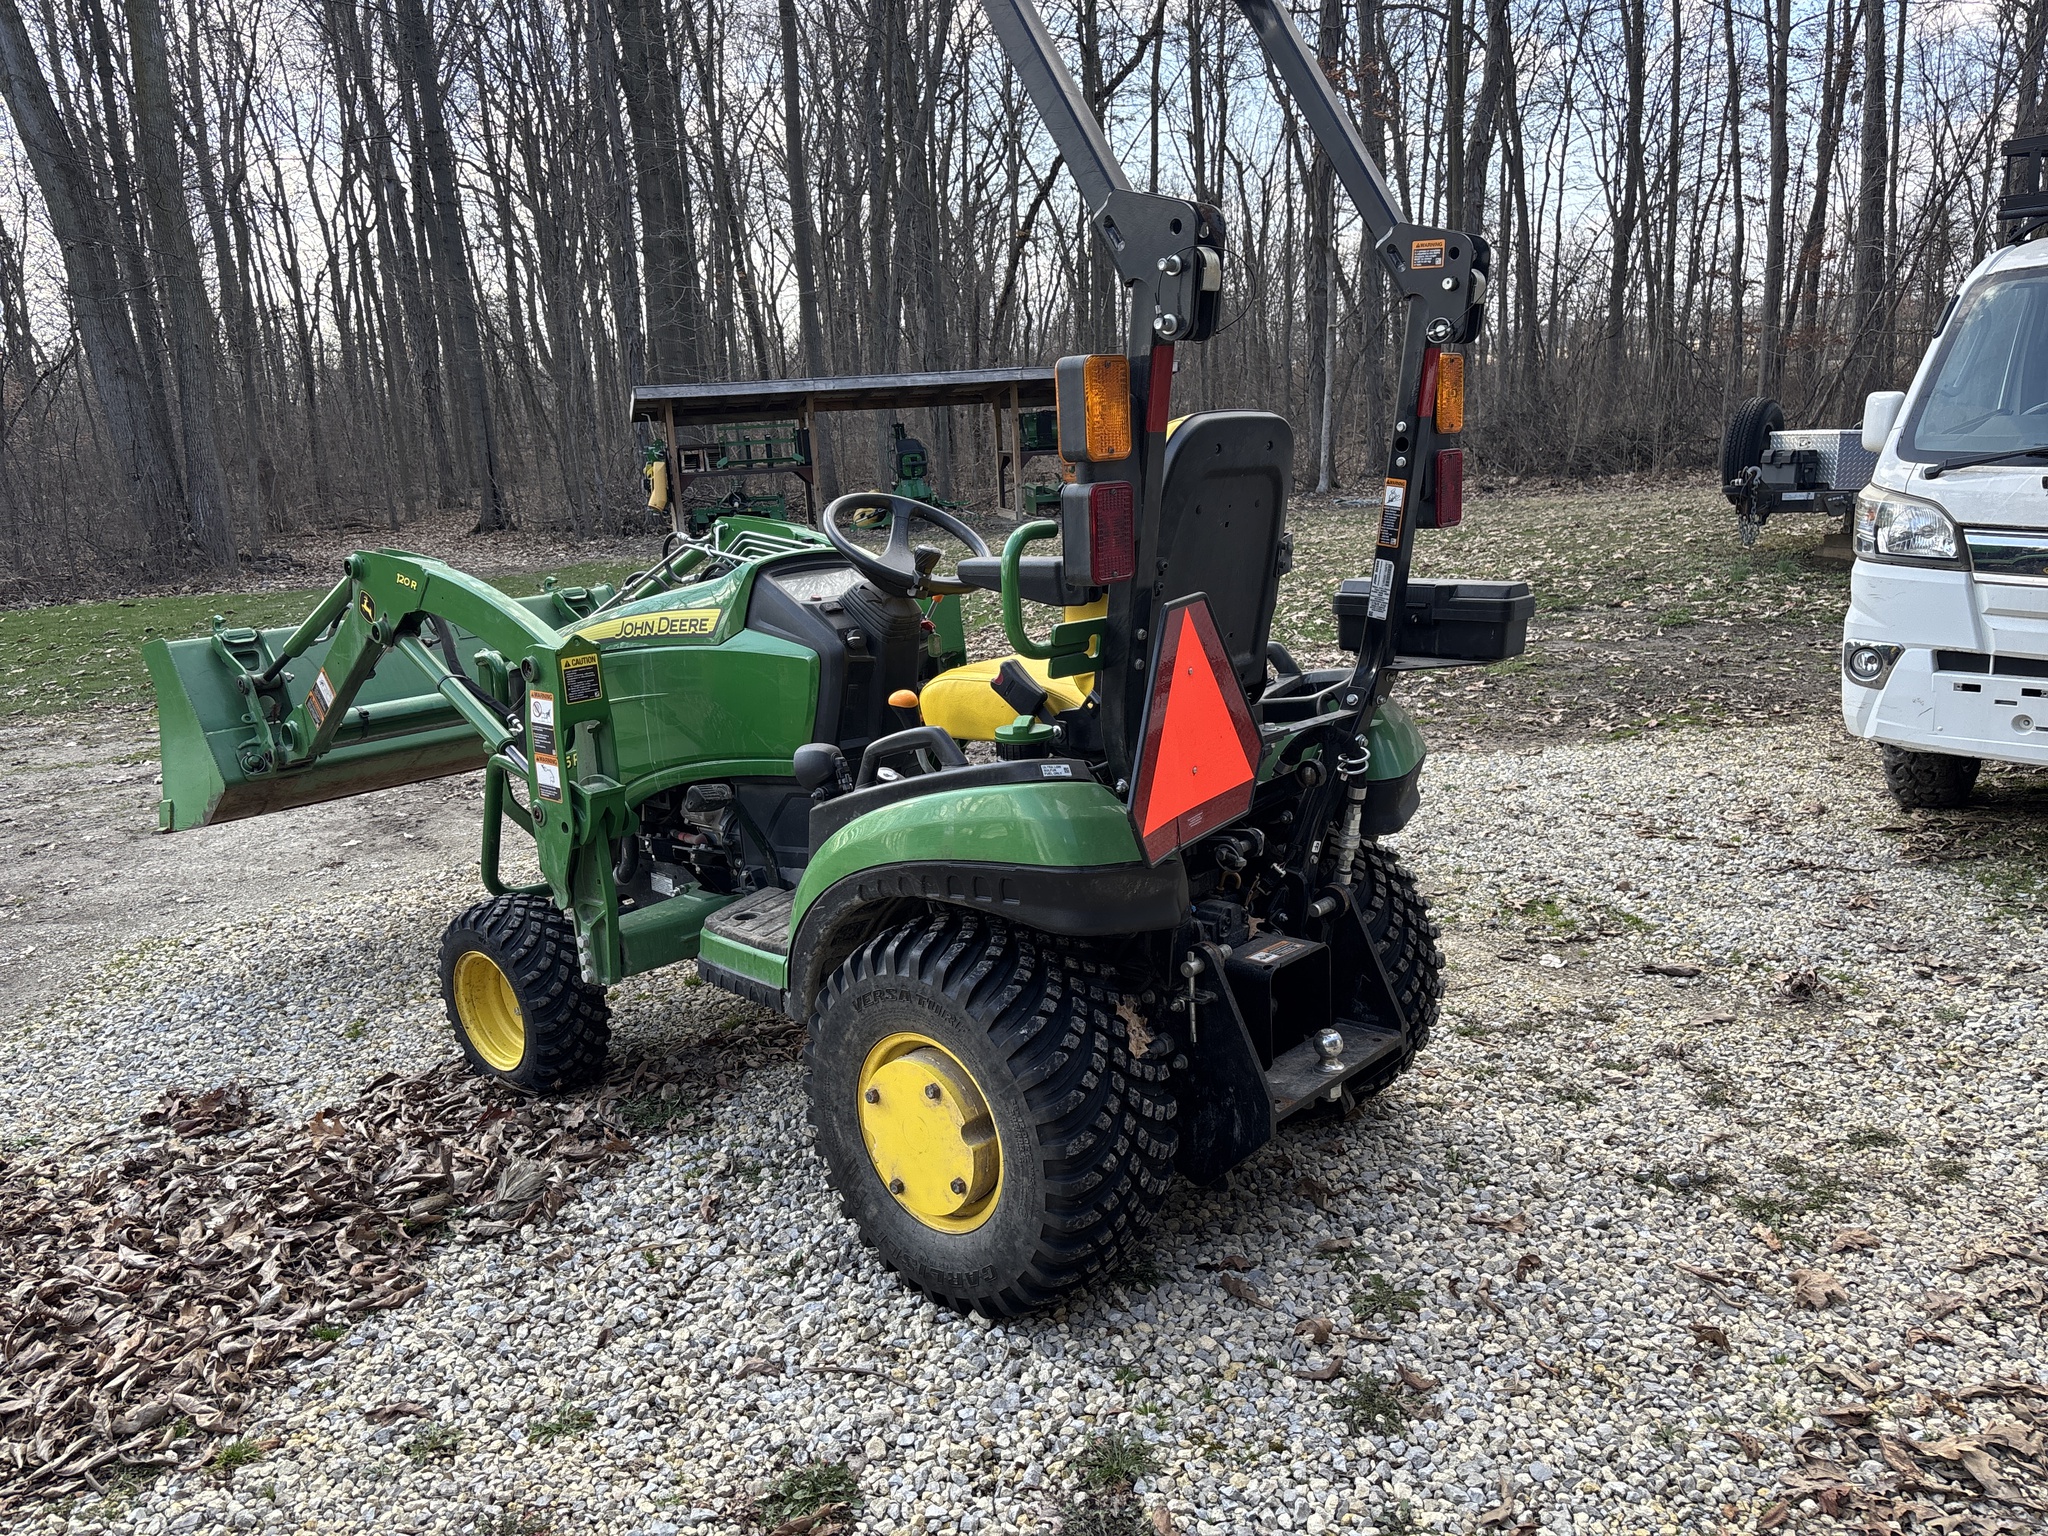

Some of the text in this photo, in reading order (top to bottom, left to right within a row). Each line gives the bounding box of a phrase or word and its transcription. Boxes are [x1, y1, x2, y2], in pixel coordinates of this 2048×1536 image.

[615, 616, 710, 637] JOHN DEERE
[571, 656, 597, 667] CAUTION
[852, 988, 913, 1013] VERSA
